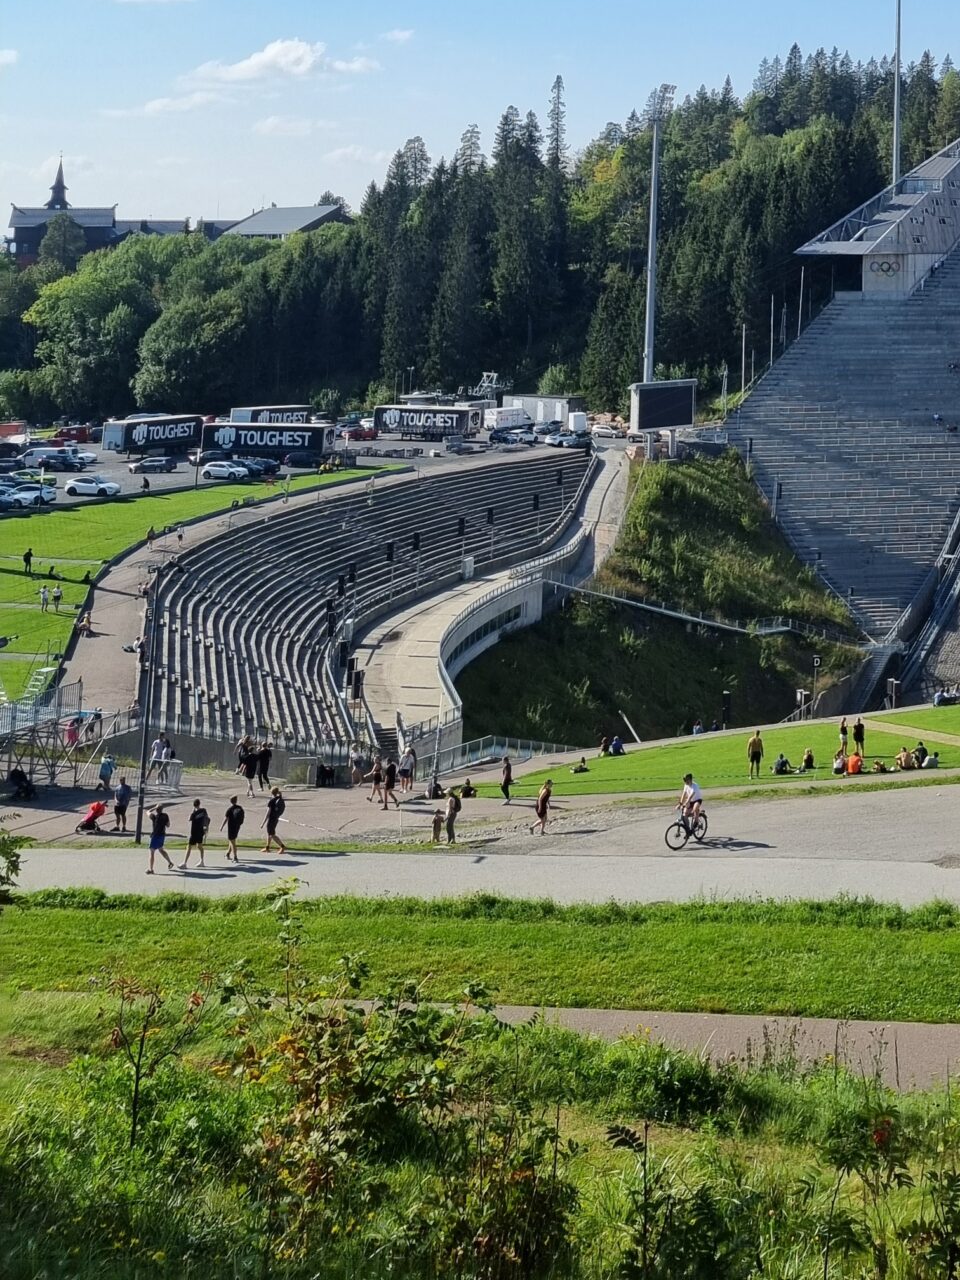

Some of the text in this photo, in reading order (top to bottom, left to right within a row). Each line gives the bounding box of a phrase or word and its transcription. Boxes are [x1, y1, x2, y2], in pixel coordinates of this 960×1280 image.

[270, 411, 308, 423] TOUGHEST
[401, 412, 459, 427] TOUGHEST
[148, 422, 196, 440] TOUGHEST
[238, 430, 312, 447] TOUGHEST
[814, 658, 820, 666] D
